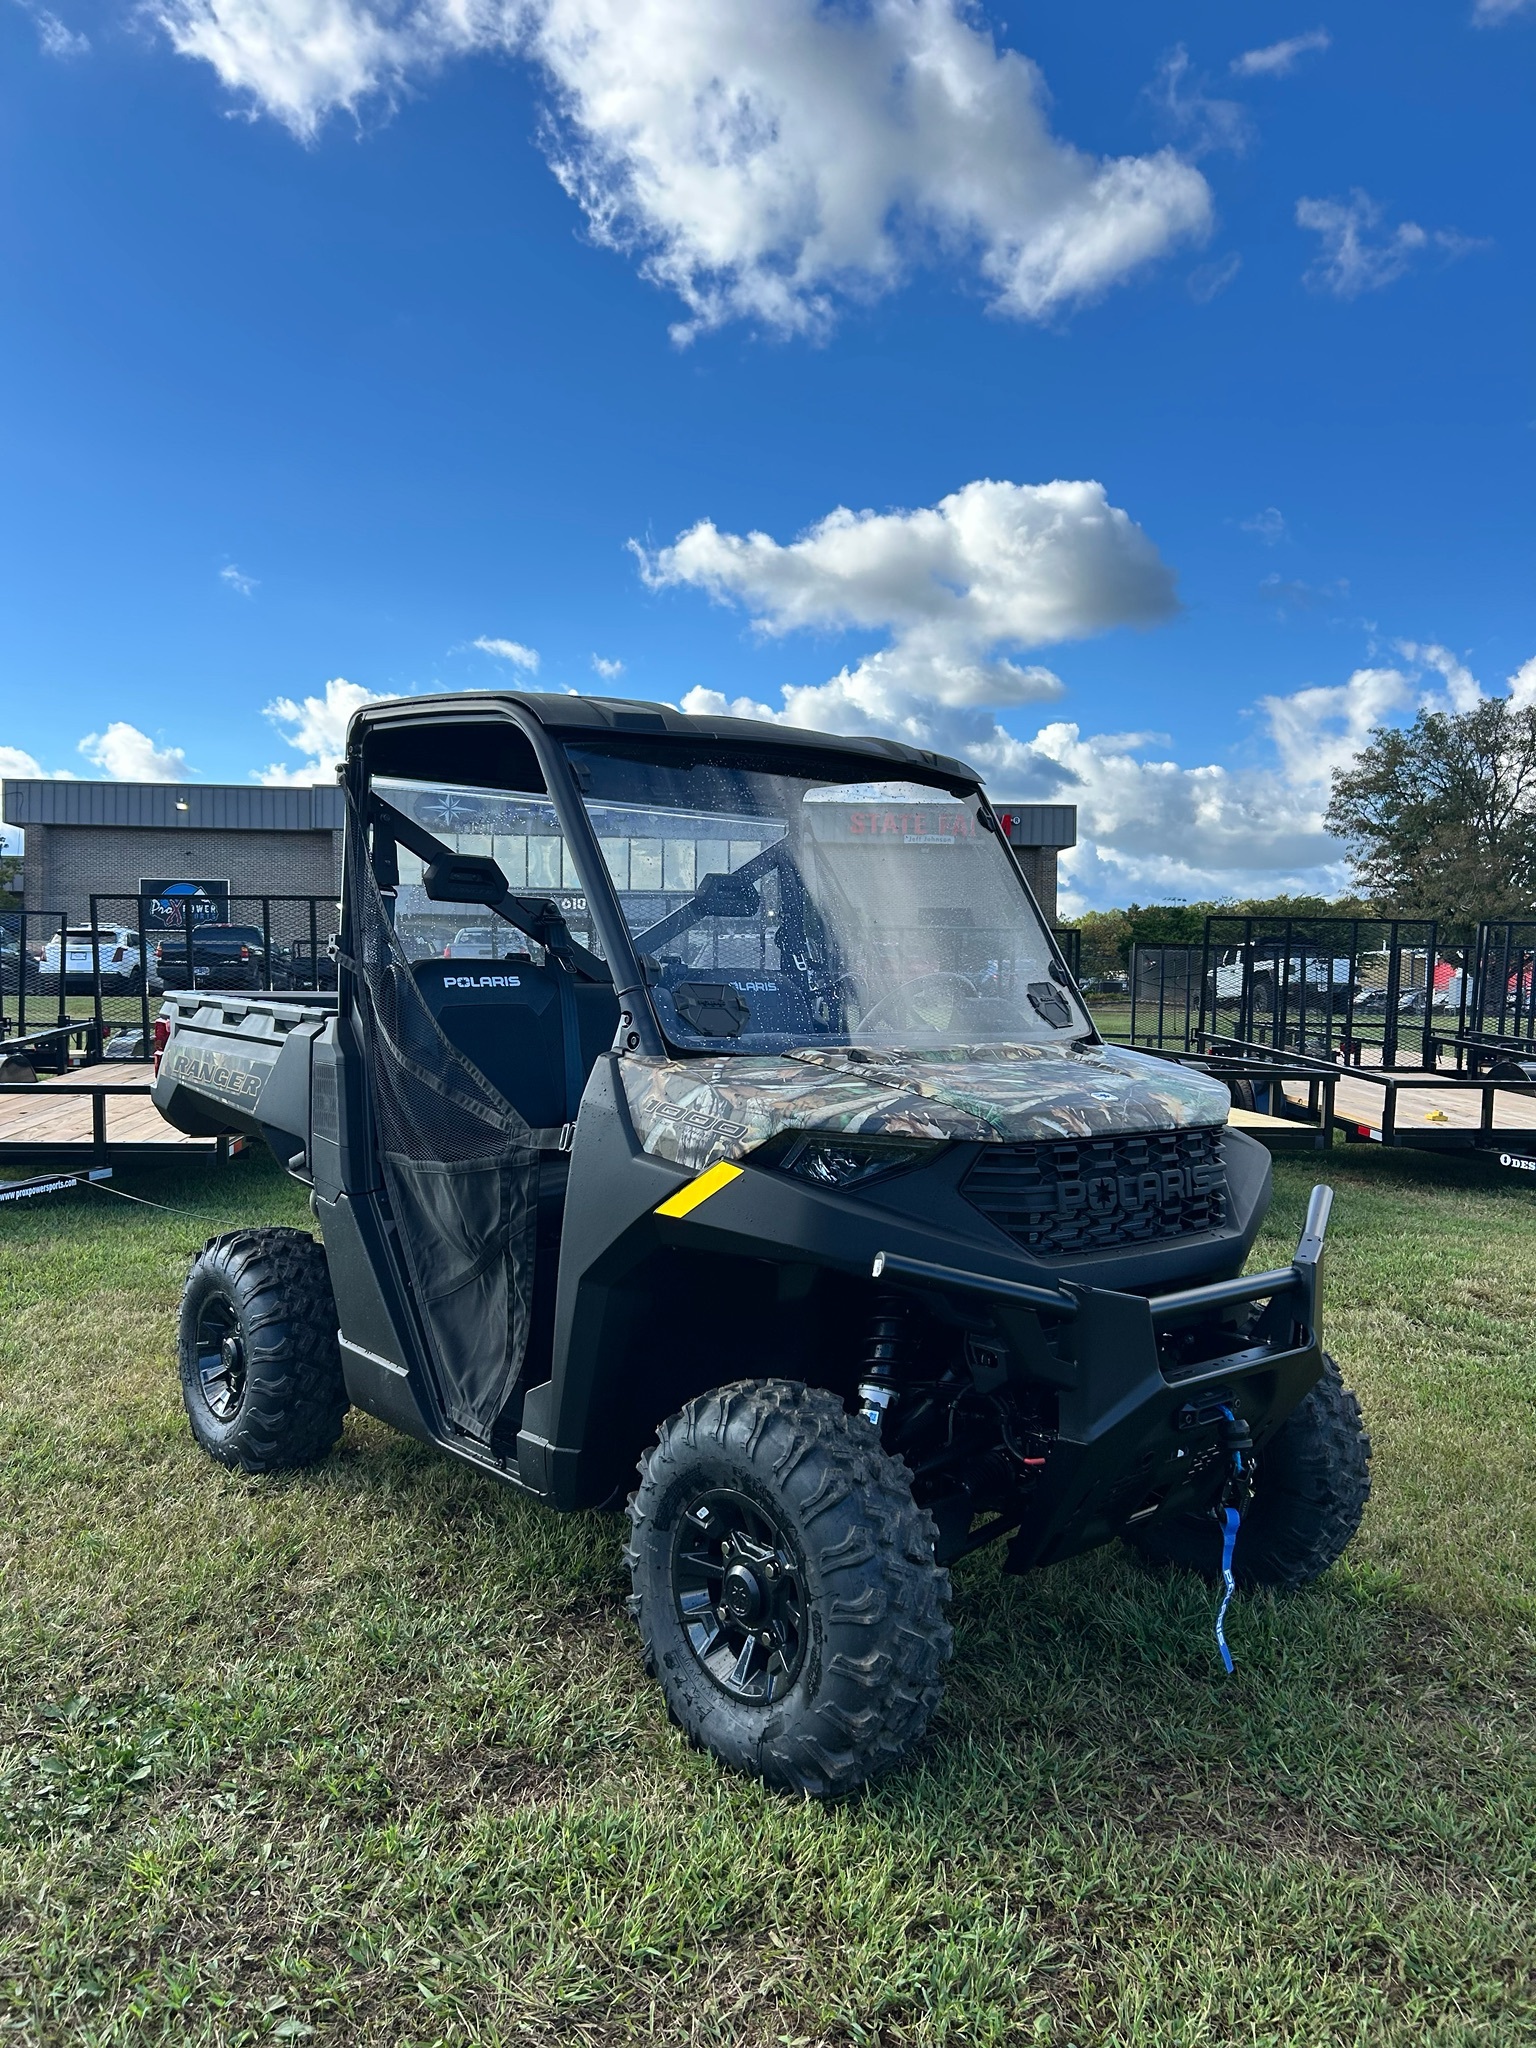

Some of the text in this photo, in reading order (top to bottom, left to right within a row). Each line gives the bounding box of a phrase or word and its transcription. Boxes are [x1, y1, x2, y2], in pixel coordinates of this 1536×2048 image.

[851, 813, 927, 835] STATE
[908, 835, 951, 843] Jeff Johnson
[561, 898, 586, 910] 610
[443, 976, 521, 988] POLARIS
[173, 1055, 262, 1097] RANGER
[644, 1098, 749, 1140] 1000
[1056, 1163, 1214, 1214] POLARIS
[1216, 1568, 1235, 1647] POLARIS
